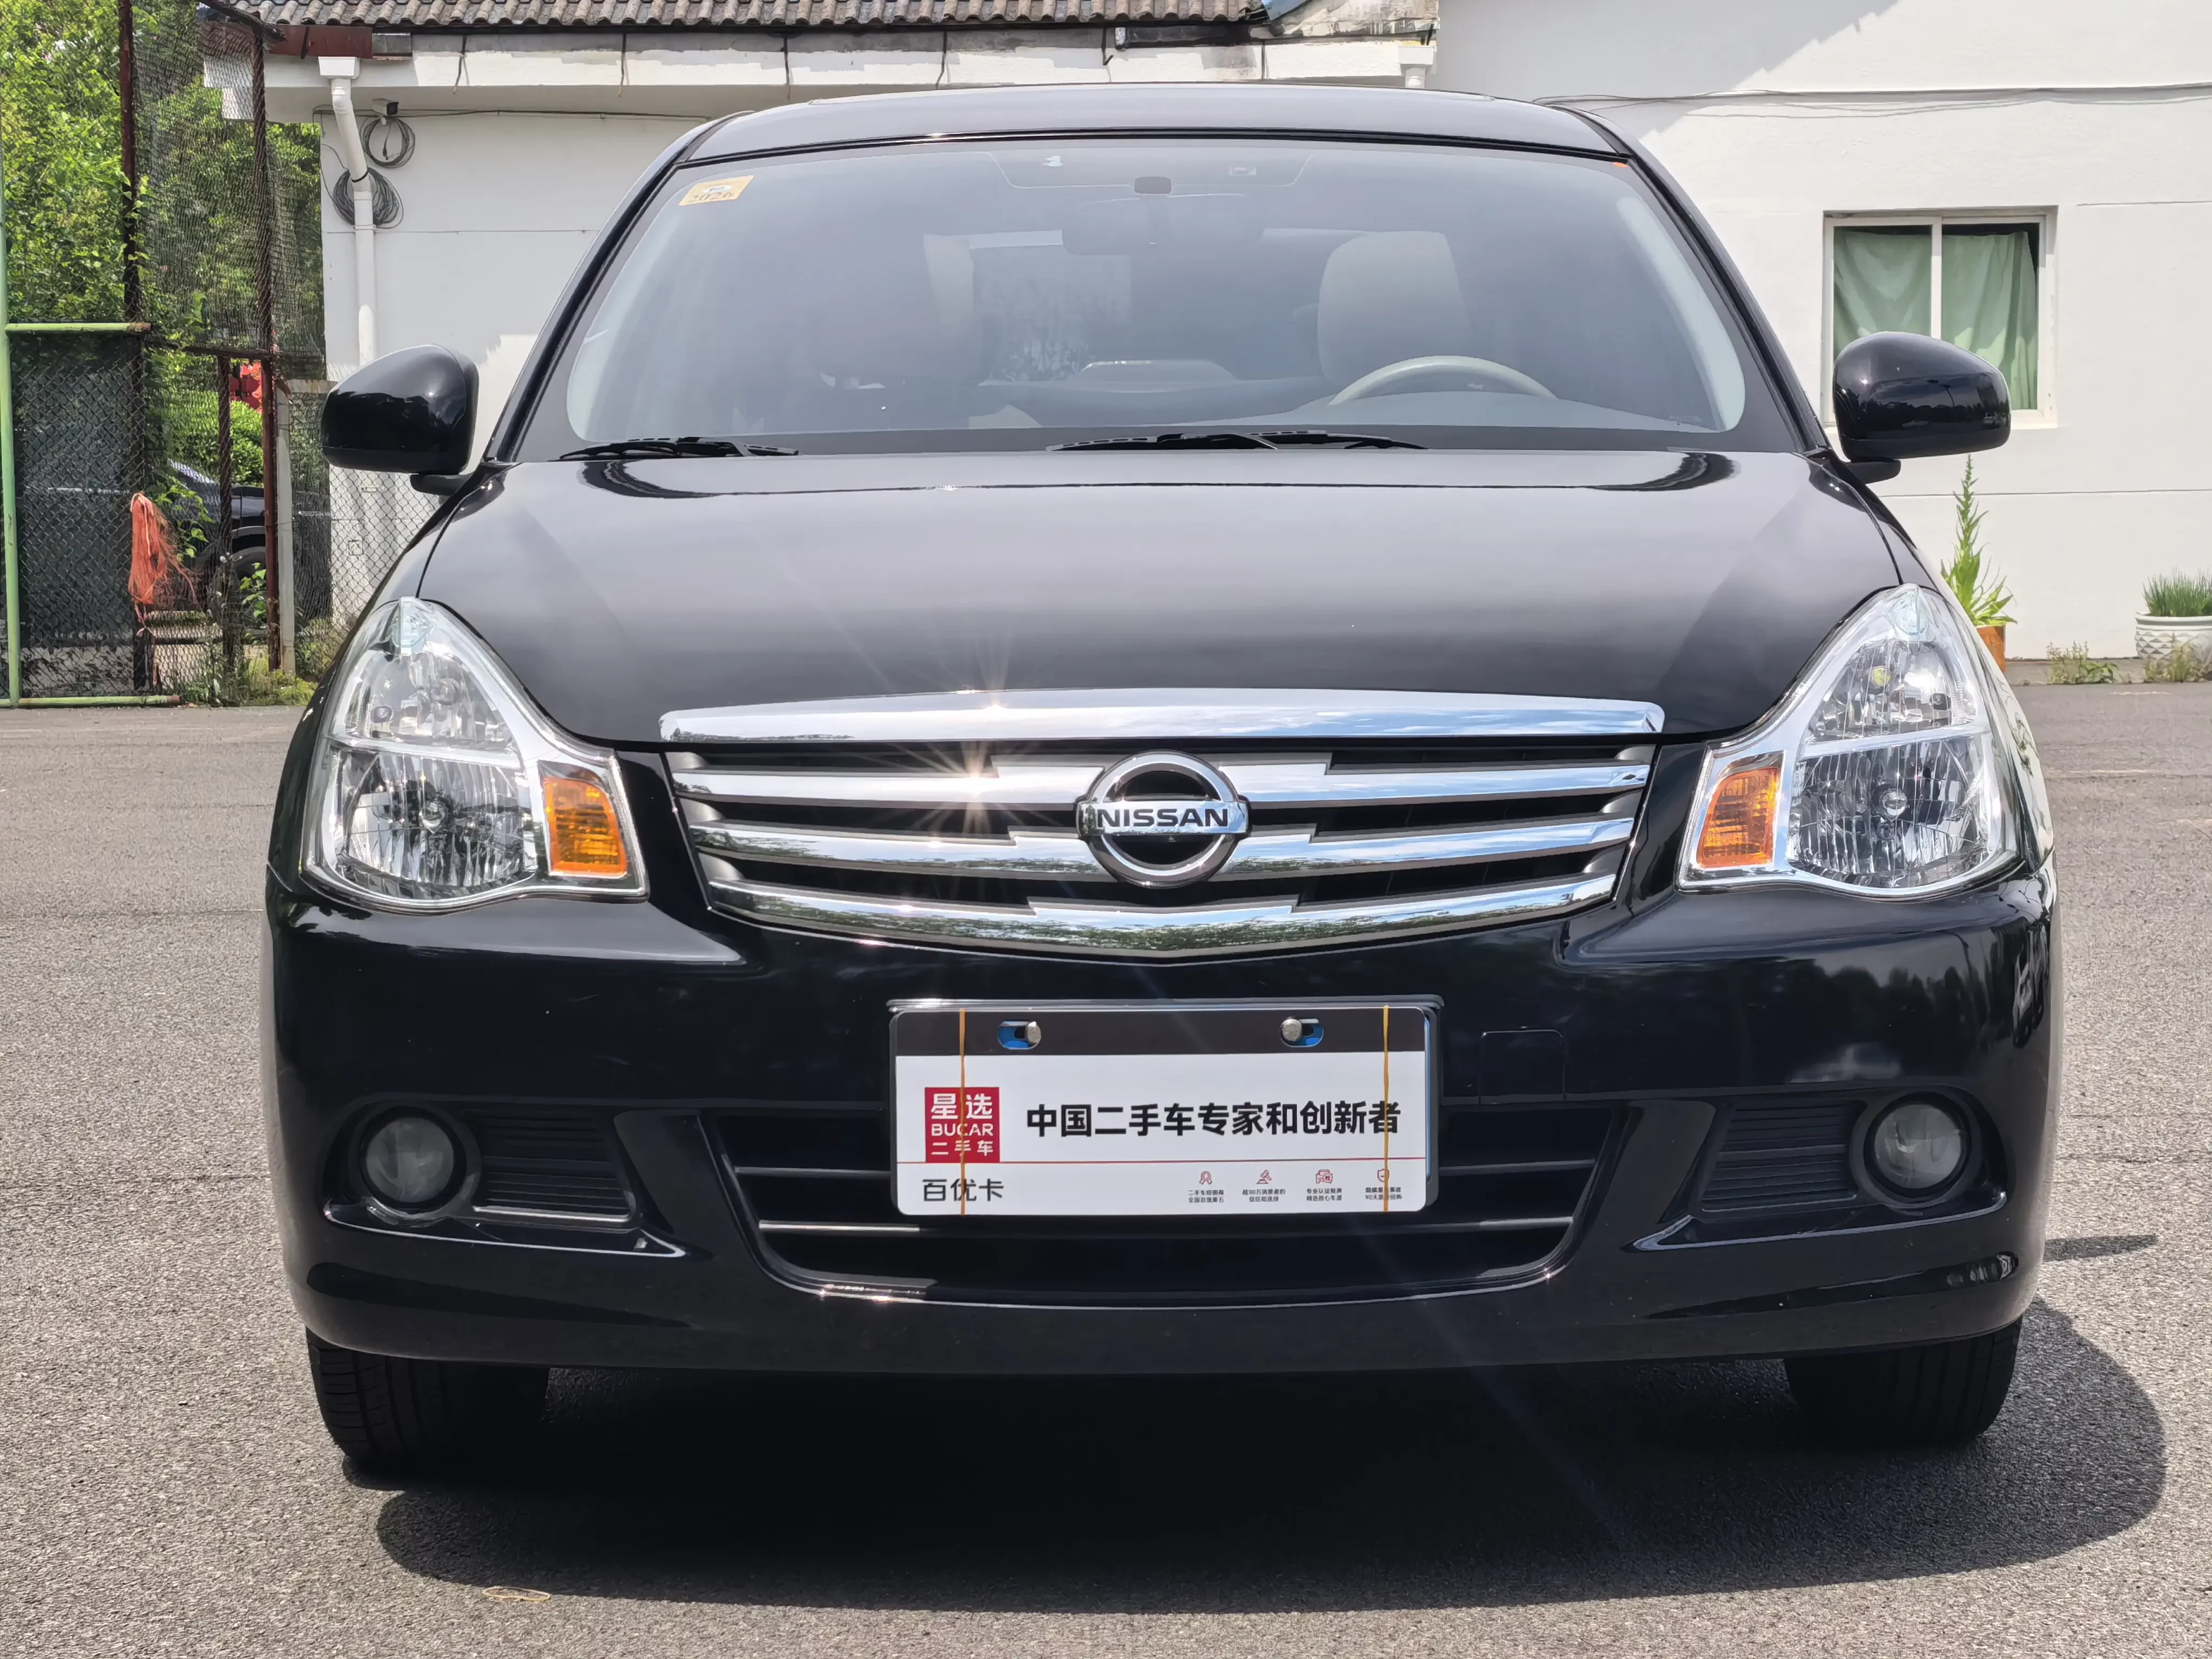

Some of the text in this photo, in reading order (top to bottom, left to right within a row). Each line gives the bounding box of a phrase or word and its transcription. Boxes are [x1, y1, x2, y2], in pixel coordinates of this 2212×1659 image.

[1097, 808, 1228, 827] NISSAN
[930, 1092, 993, 1120] 星选
[1027, 1100, 1401, 1137] 中国二手车专家和创新者
[931, 1123, 994, 1136] BUCAR
[931, 1139, 994, 1156] 二手车
[922, 1178, 1004, 1202] 百优卡
